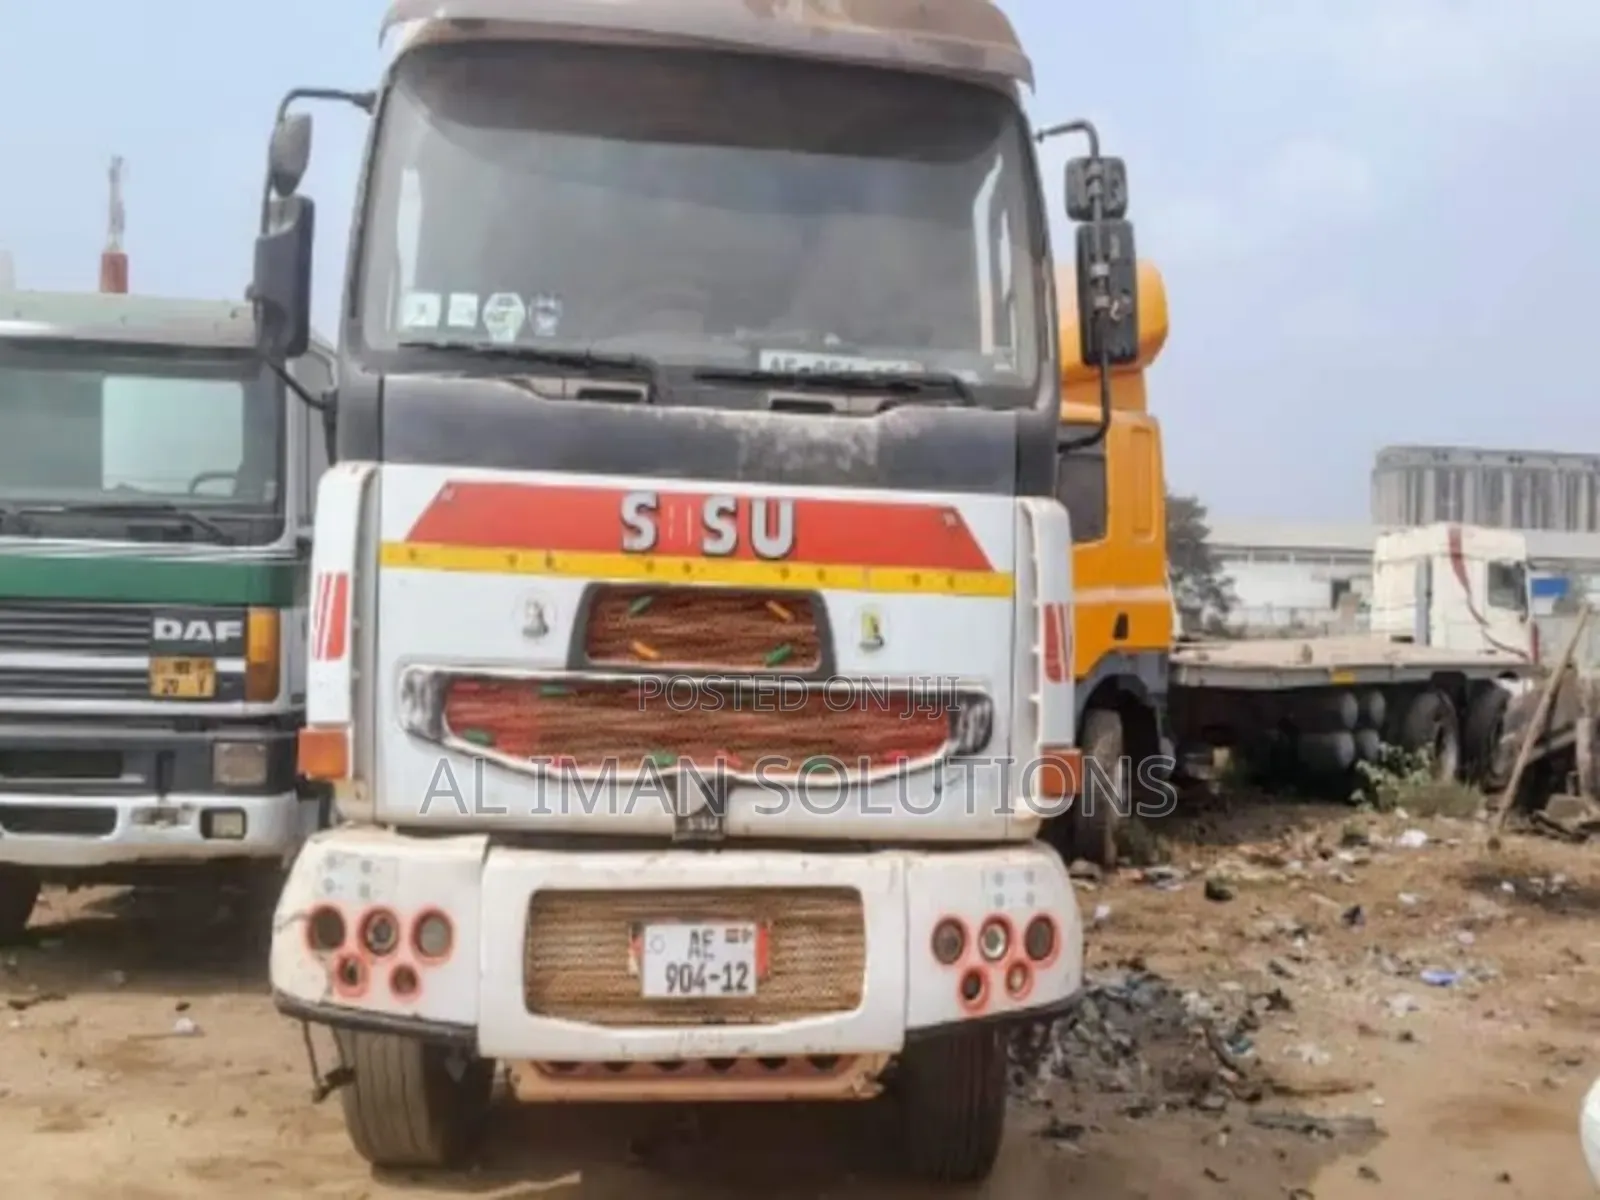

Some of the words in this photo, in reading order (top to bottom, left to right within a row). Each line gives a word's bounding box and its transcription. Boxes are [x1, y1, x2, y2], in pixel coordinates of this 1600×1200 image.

[619, 491, 797, 560] SSU
[153, 617, 244, 642] DAF
[687, 929, 716, 960] AE
[665, 961, 749, 993] 904-12
